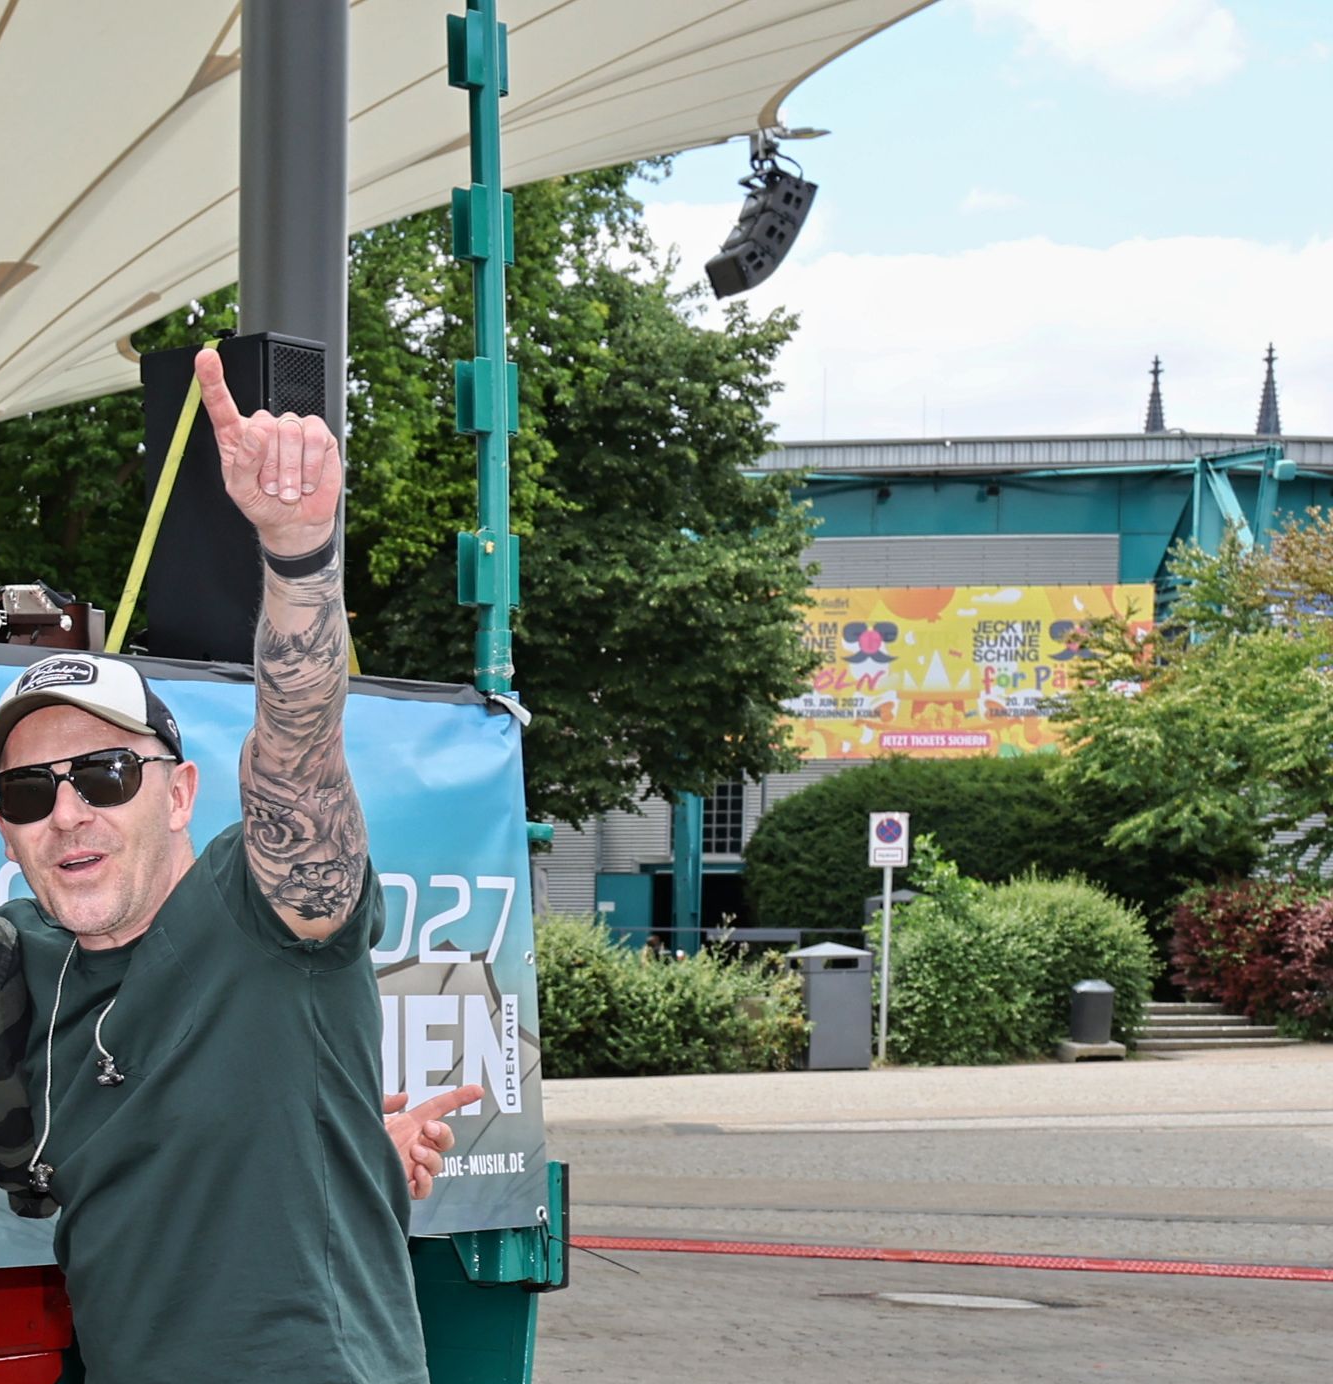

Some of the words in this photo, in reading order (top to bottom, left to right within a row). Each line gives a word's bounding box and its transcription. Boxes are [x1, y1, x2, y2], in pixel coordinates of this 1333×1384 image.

[972, 620, 1017, 634] JECK
[1021, 620, 1041, 633] IM
[973, 635, 1040, 648] SUNNE
[973, 649, 1040, 662] SCHING
[812, 666, 886, 691] ÖLN
[982, 665, 1027, 695] för
[370, 873, 516, 963] 027
[505, 1002, 517, 1038] AIR
[505, 1047, 517, 1107] OPEN
